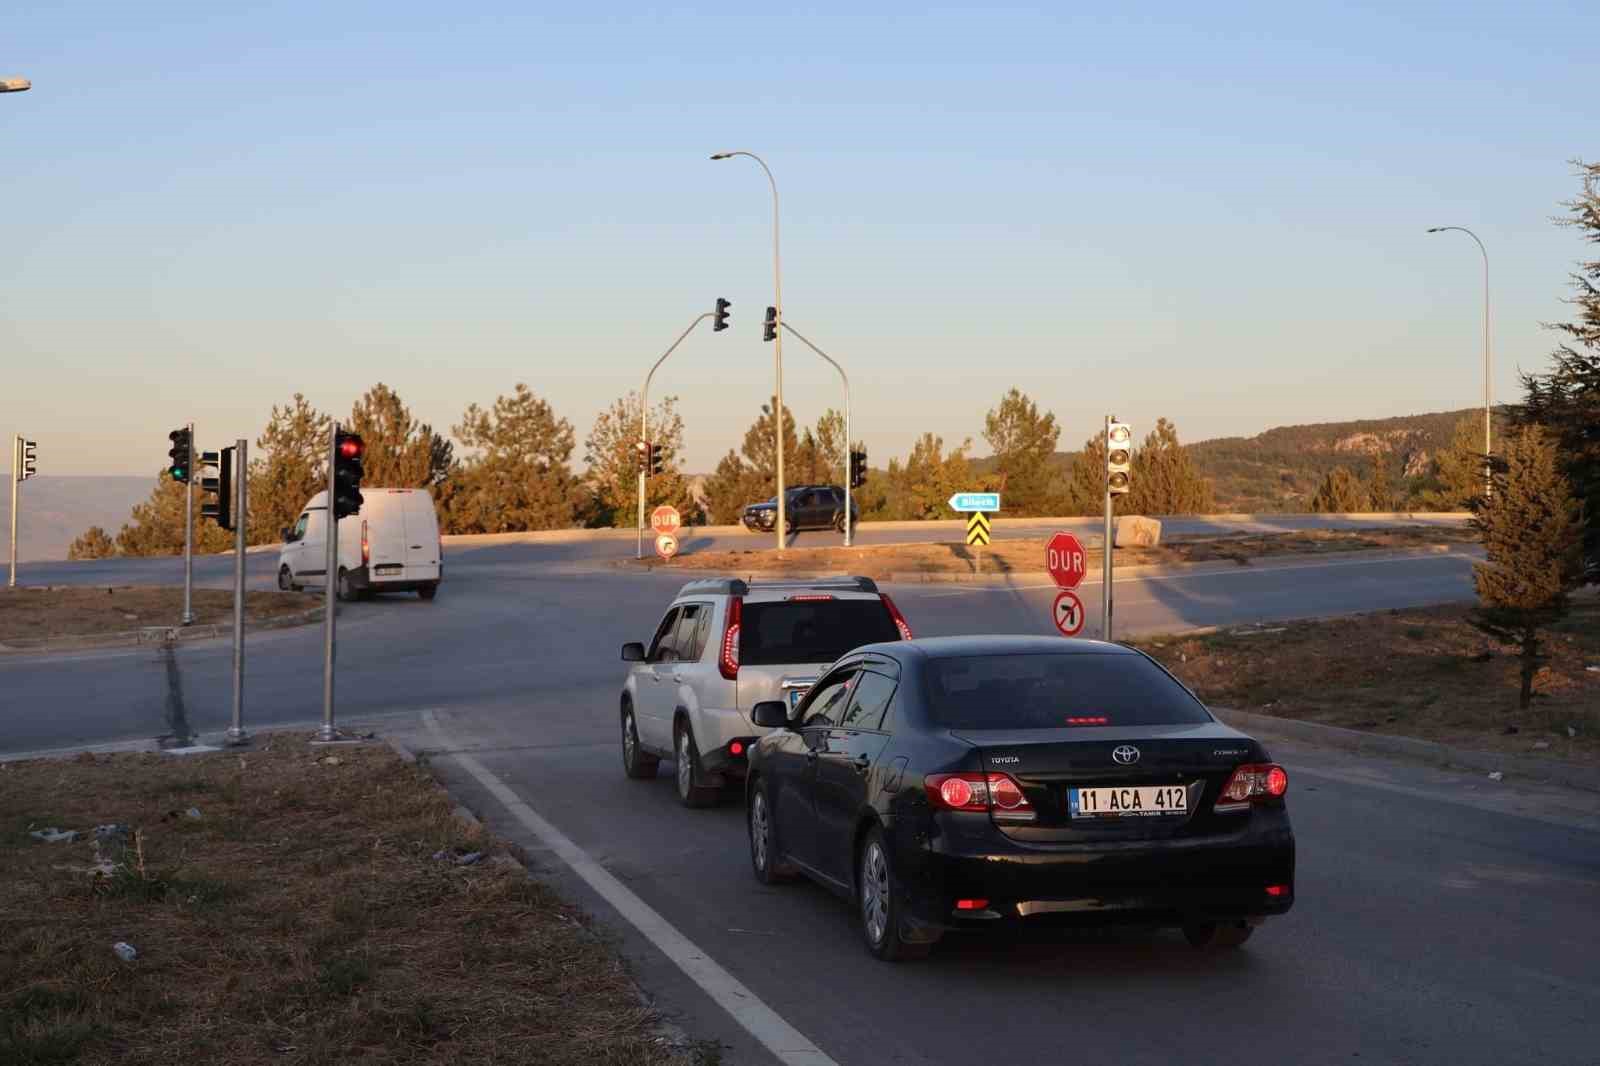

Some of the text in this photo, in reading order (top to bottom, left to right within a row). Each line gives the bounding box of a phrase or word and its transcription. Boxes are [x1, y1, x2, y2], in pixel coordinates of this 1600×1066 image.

[1049, 549, 1083, 573] DUR
[1081, 788, 1185, 811] 11 ACA 412
